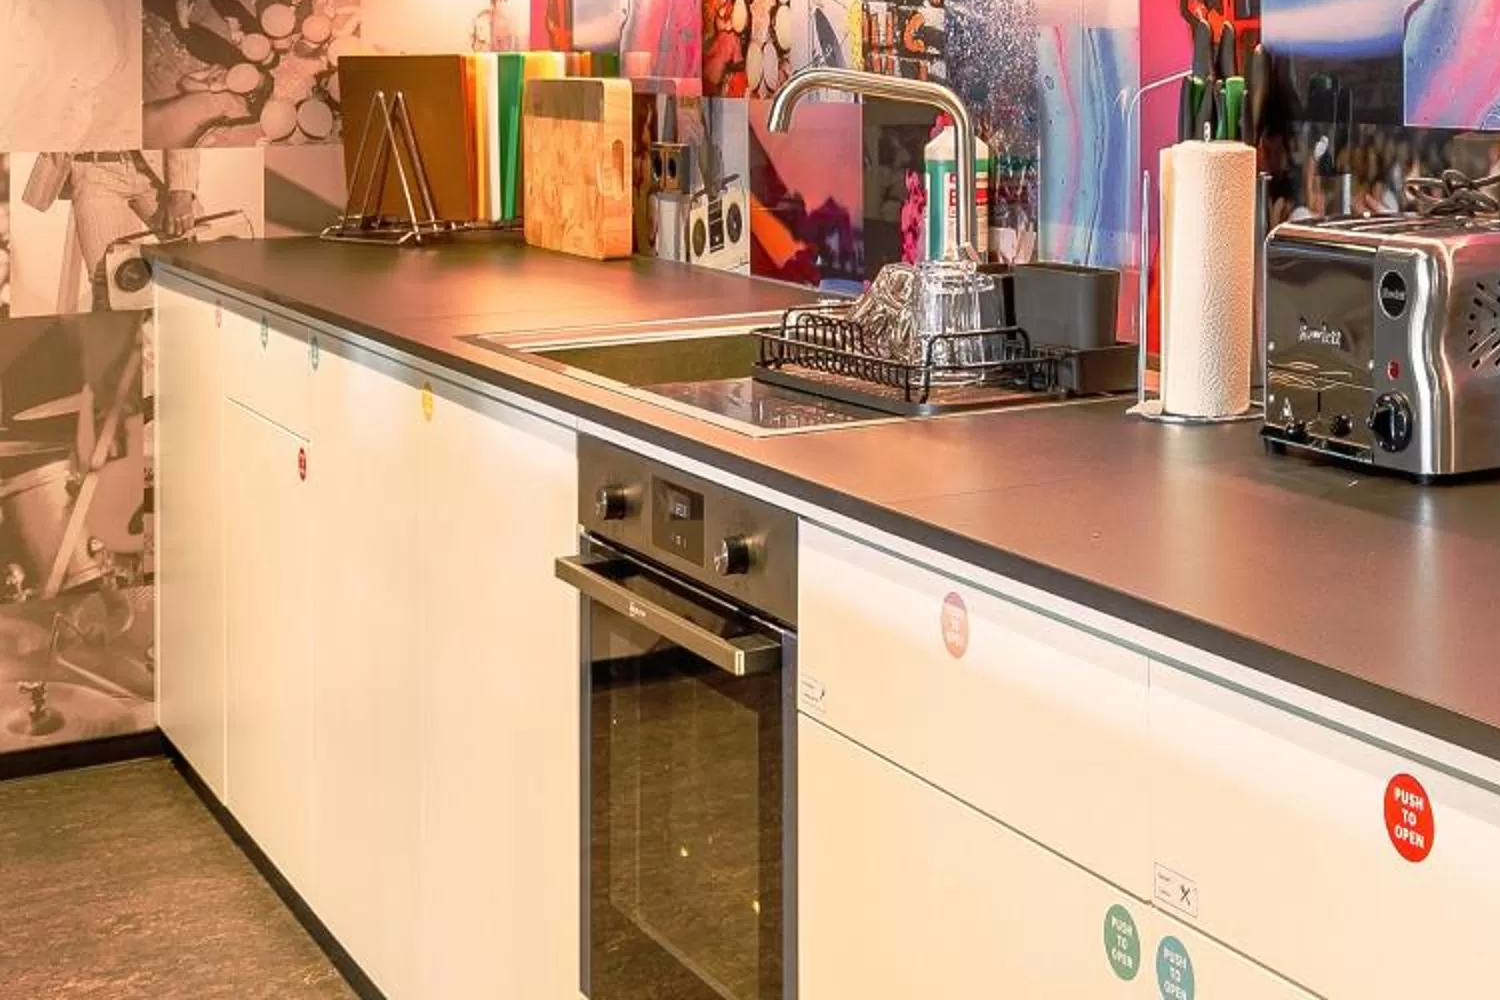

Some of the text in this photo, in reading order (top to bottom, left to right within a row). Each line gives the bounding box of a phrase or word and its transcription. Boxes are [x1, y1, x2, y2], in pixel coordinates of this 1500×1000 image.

[1394, 786, 1425, 812] PUSH
[1401, 807, 1417, 826] TO
[1394, 824, 1425, 849] OPEN
